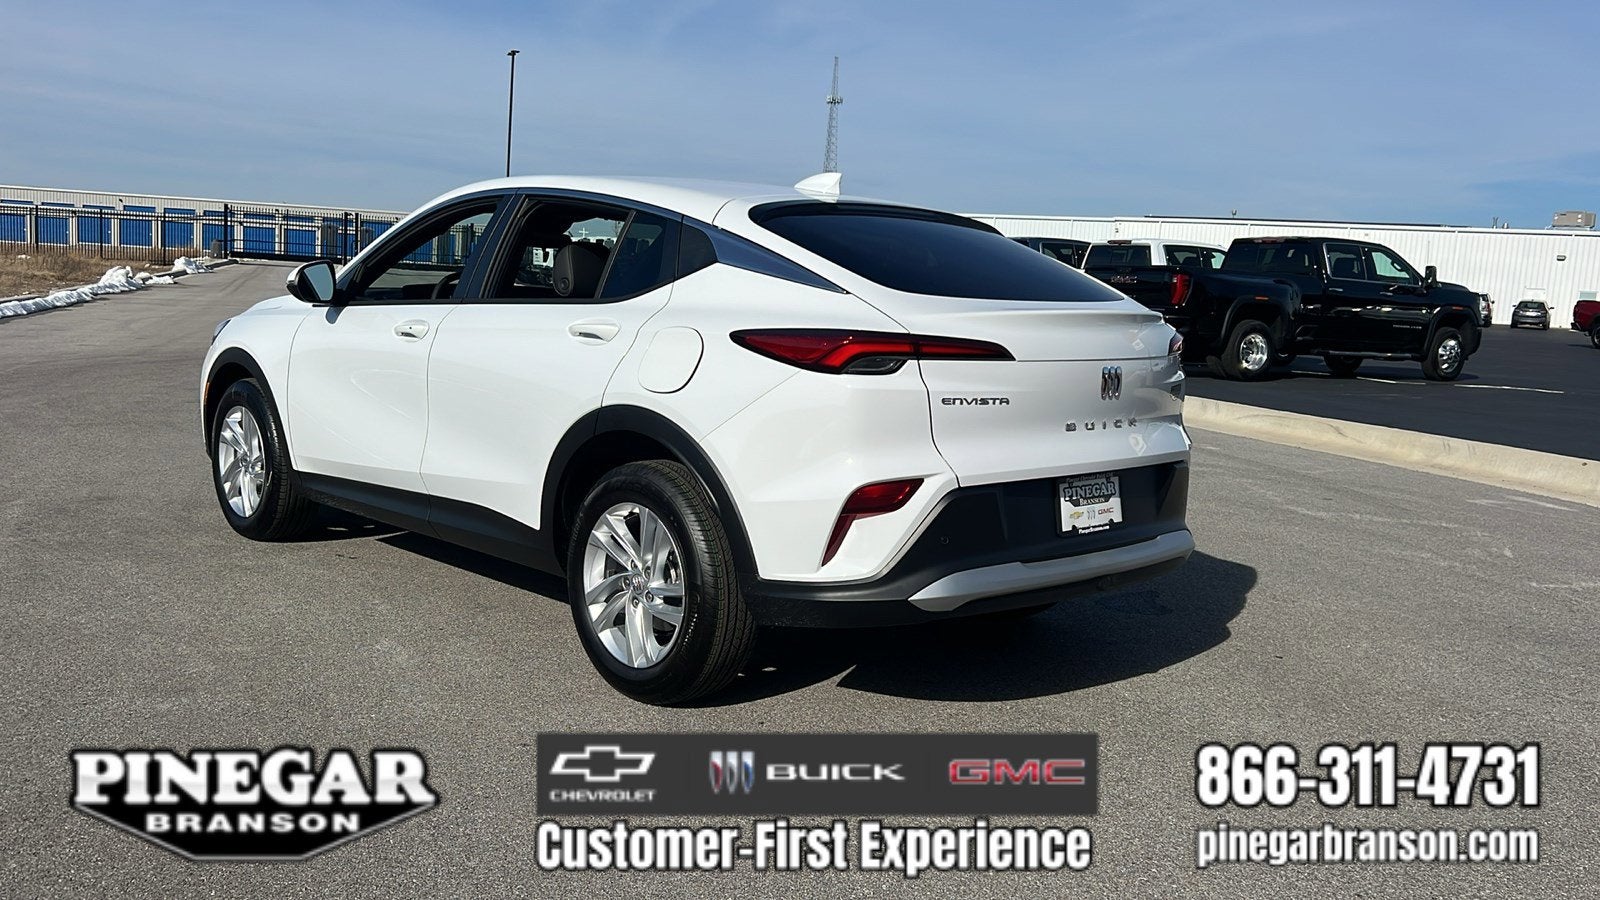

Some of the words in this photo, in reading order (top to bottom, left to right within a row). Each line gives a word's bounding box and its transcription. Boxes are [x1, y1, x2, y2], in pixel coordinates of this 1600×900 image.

[941, 397, 1010, 406] ENVISTA
[1065, 417, 1138, 432] BUICK
[1063, 482, 1116, 501] PINEGAR
[1098, 507, 1114, 515] GMC
